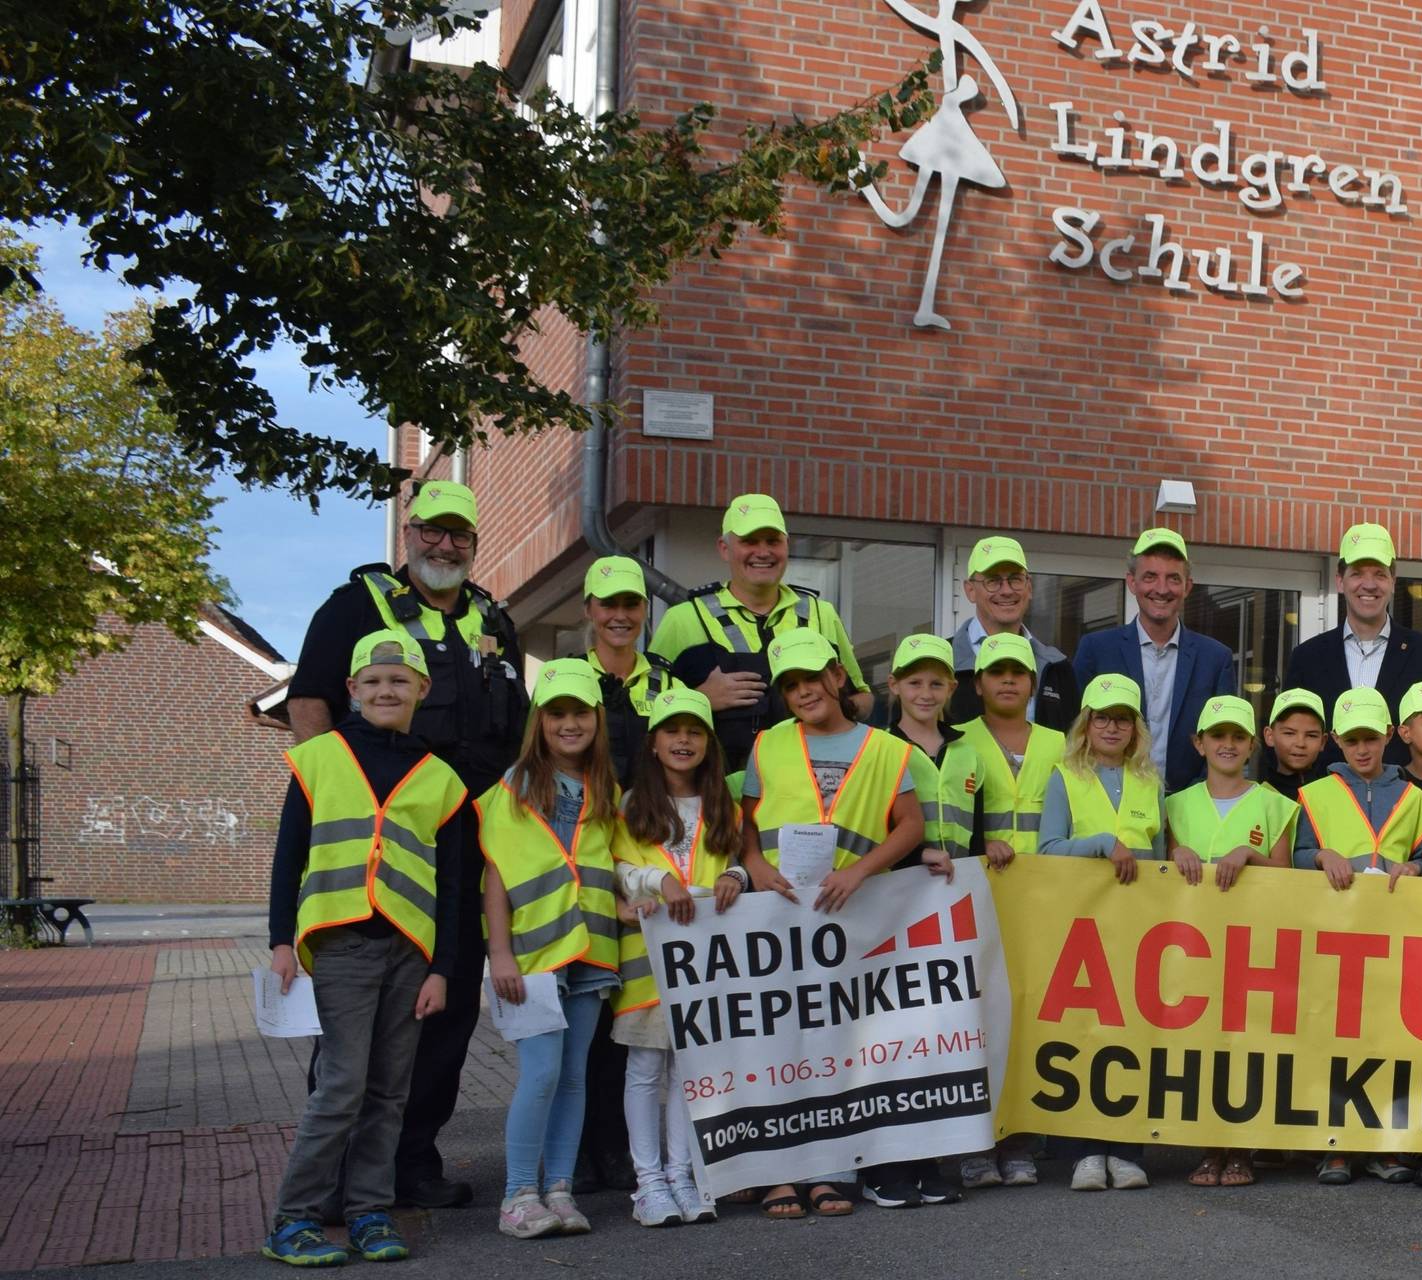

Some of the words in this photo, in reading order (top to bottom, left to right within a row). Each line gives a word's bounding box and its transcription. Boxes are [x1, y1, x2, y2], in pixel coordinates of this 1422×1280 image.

[1050, 0, 1326, 91] Astrid
[1050, 102, 1408, 213] Lindgren
[1049, 207, 1303, 298] Schule
[662, 922, 848, 989] RADIO
[669, 954, 981, 1050] KIEPENKERL
[766, 1056, 836, 1087] 106.3
[860, 1037, 930, 1067] 107.4
[703, 1121, 759, 1151] 100%
[765, 1108, 844, 1138] SICHER
[849, 1094, 891, 1122] ZUR
[896, 1082, 989, 1112] SCHULE.
